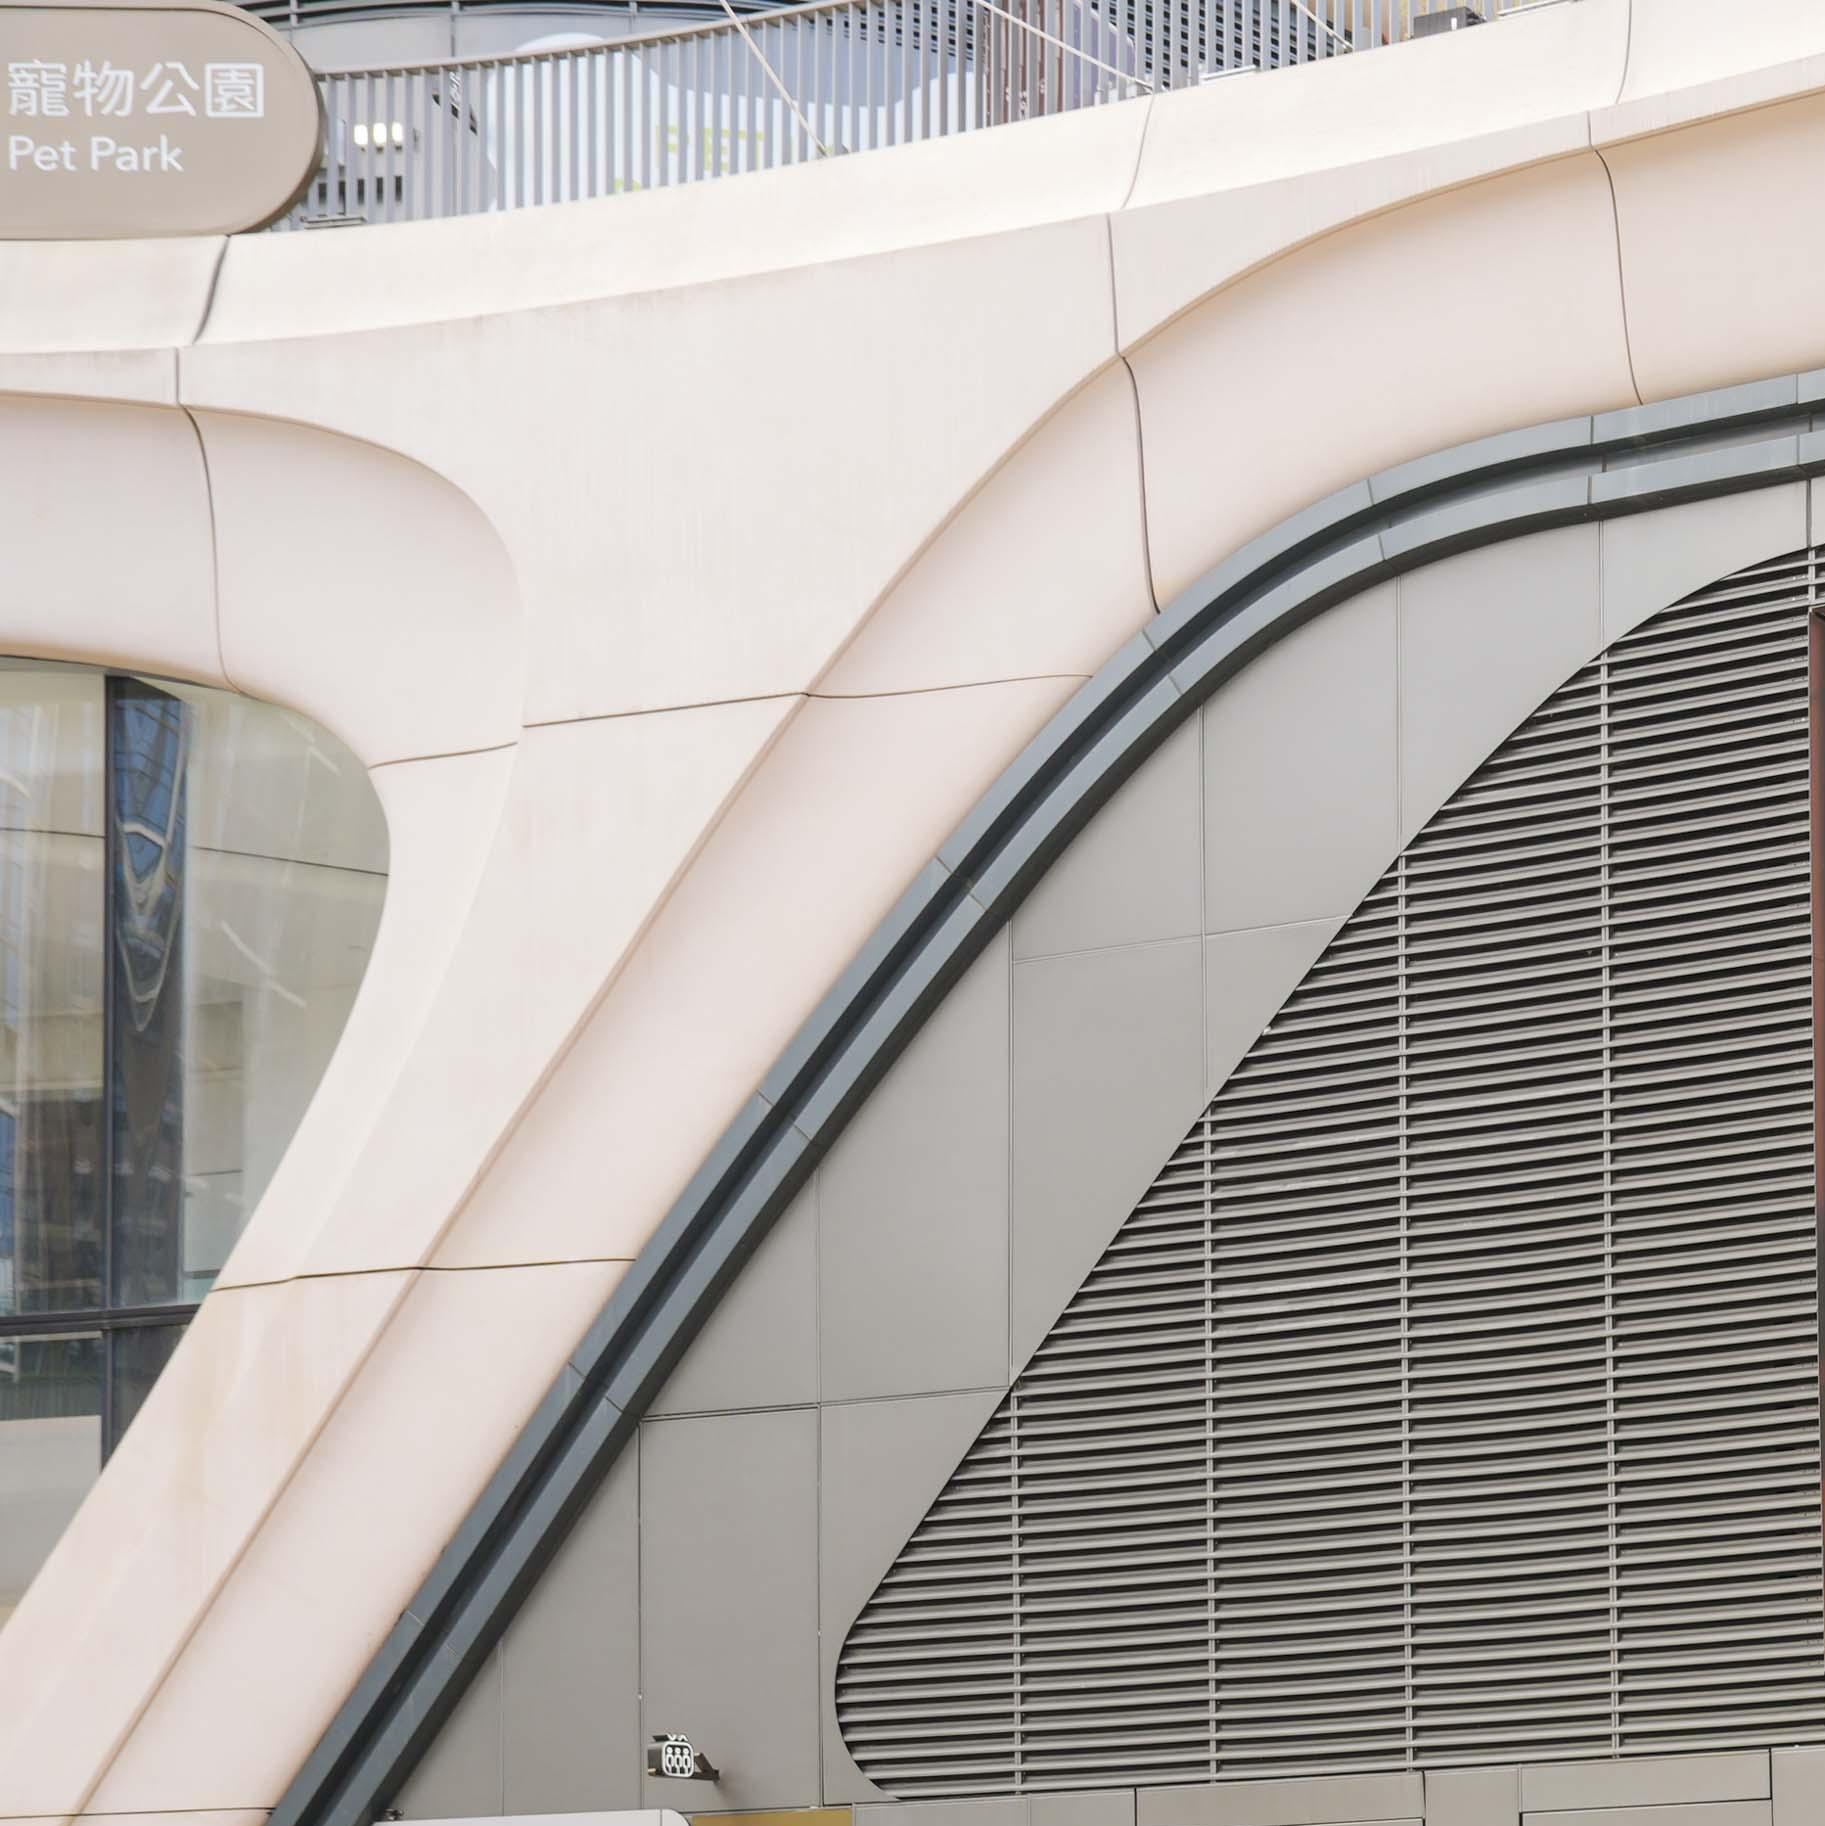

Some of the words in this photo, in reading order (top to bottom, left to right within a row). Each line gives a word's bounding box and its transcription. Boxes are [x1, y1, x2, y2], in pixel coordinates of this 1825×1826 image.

[7, 58, 265, 119] 寵物公園
[8, 134, 79, 172] Pet
[90, 133, 185, 173] Park
